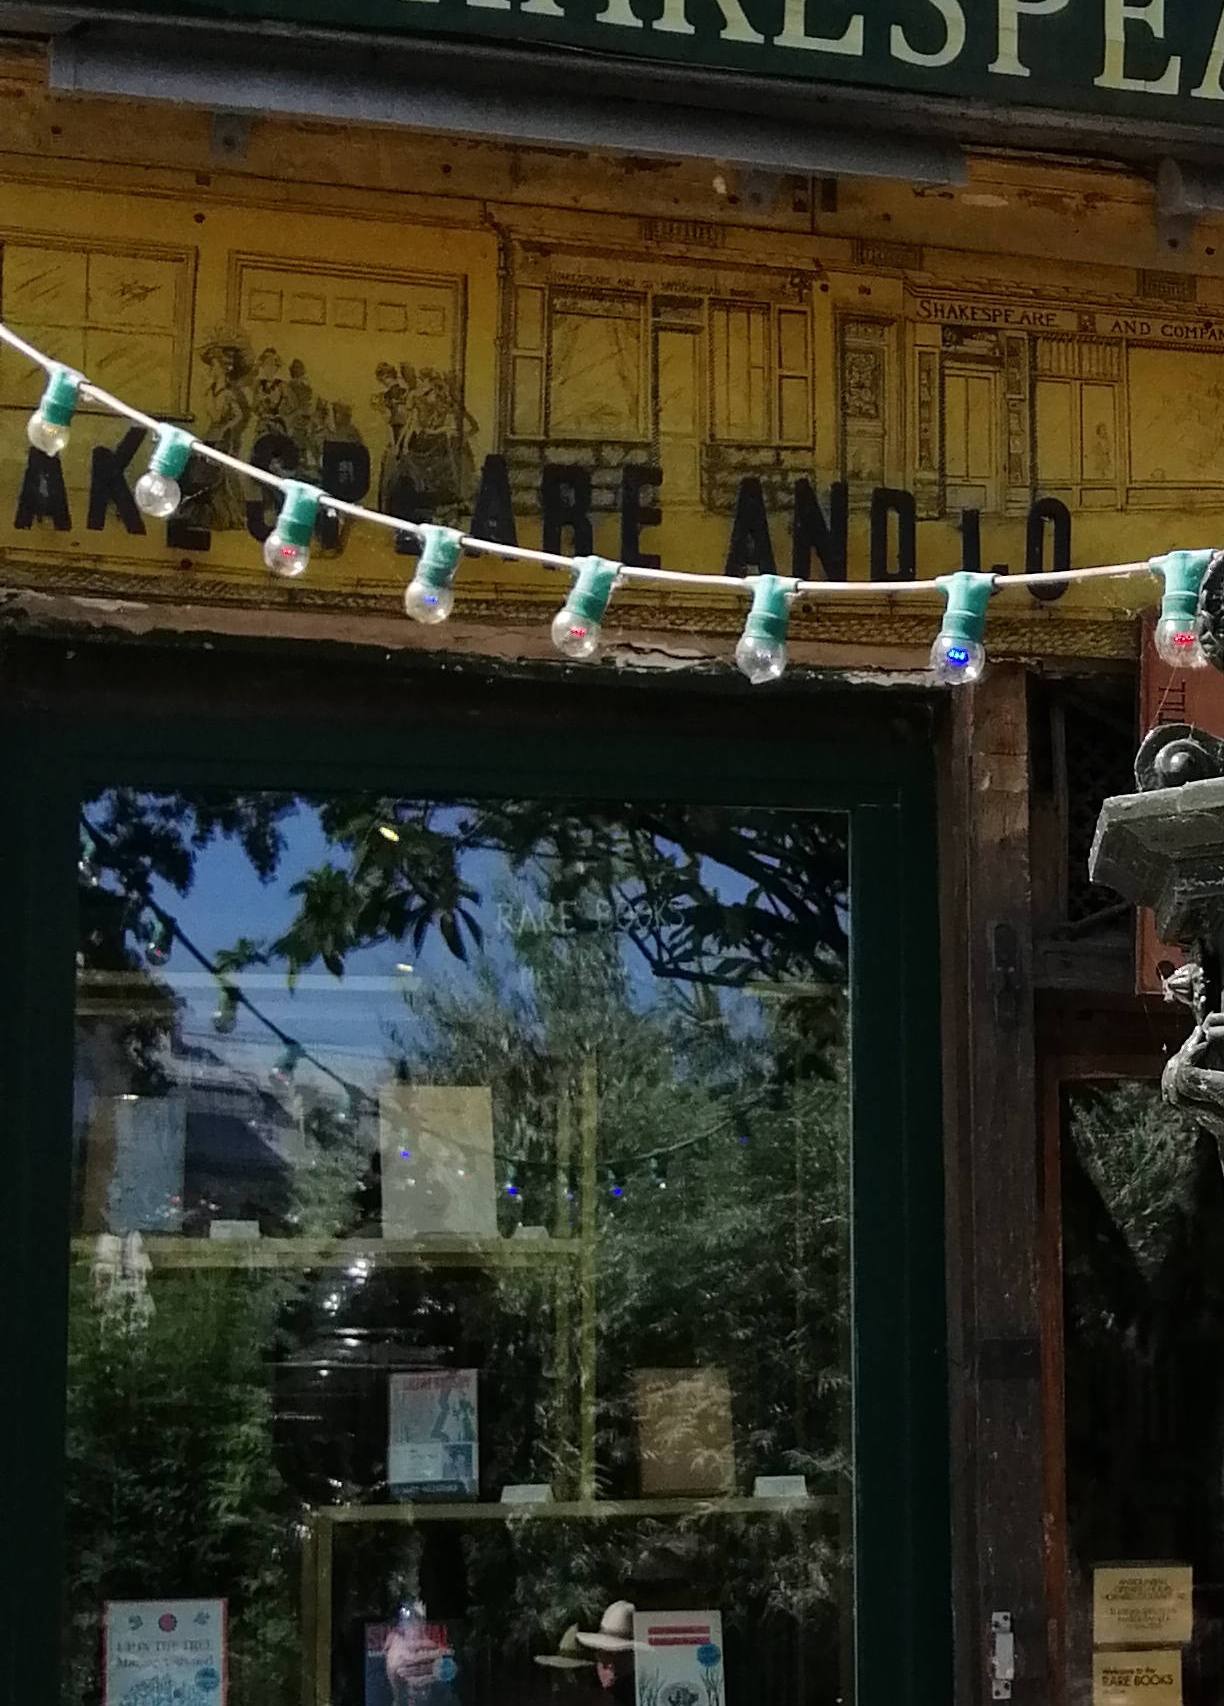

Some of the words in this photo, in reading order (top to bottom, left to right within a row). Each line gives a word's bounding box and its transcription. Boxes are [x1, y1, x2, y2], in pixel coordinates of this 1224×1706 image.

[915, 297, 1059, 328] SHAKESPEARE
[1110, 319, 1152, 336] AND
[724, 477, 890, 584] AND
[497, 900, 578, 936] RARE
[1101, 1675, 1132, 1688] RARE
[1133, 1673, 1174, 1687] BOOKS
